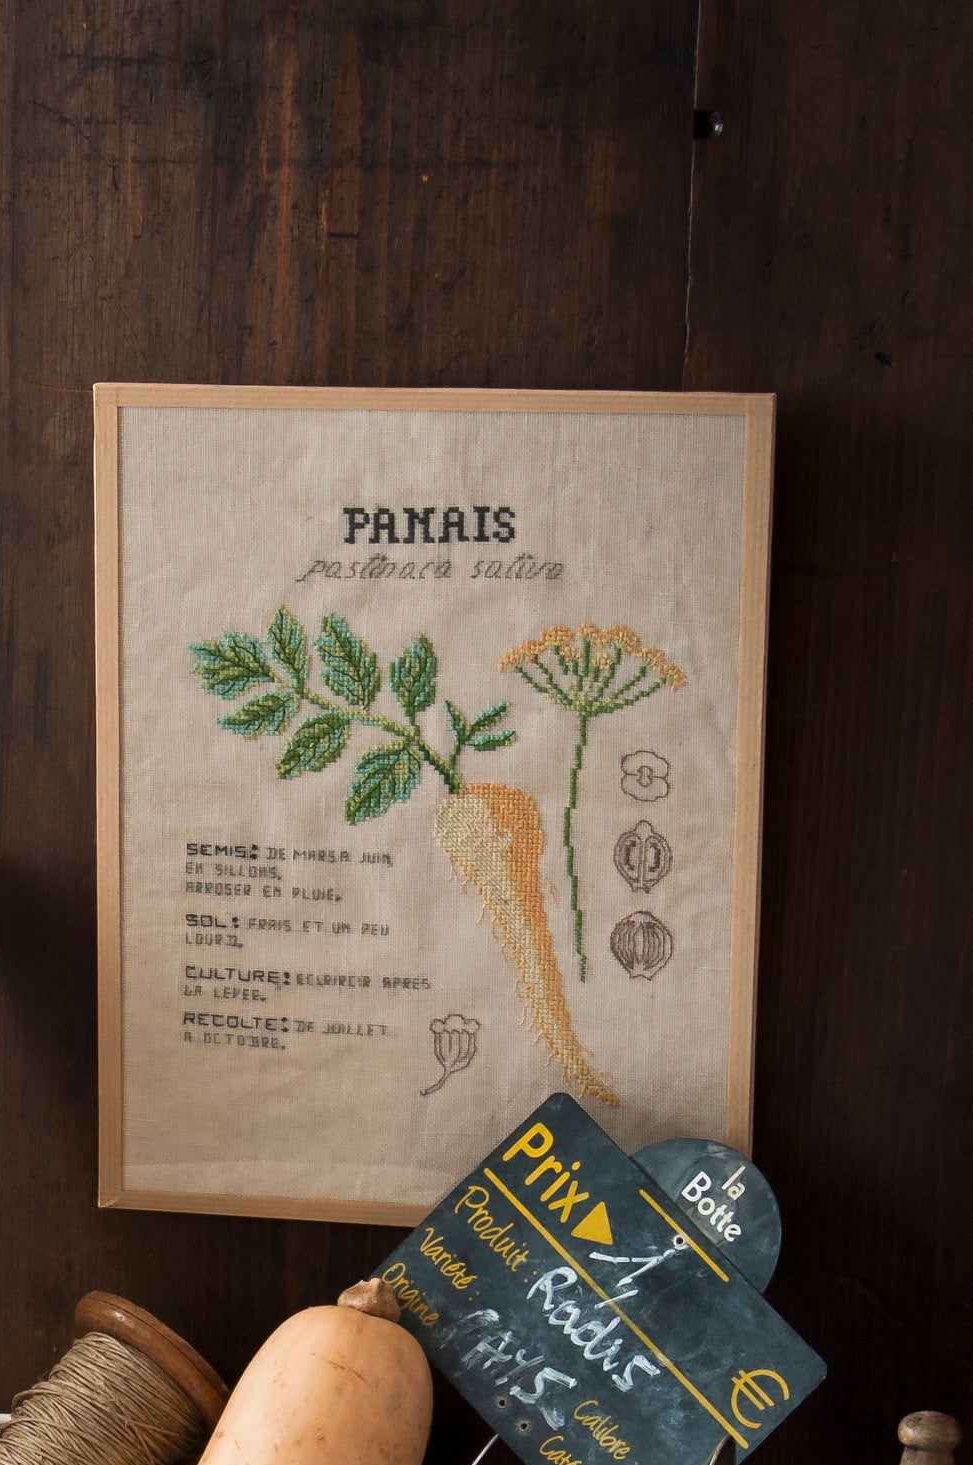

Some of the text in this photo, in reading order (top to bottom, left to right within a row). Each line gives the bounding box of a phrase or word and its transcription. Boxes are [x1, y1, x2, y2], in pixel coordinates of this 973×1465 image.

[343, 504, 516, 544] PANAIS
[296, 552, 565, 581] pastinaca sativa
[266, 847, 286, 861] DE
[293, 848, 335, 864] MARS
[185, 862, 204, 875] EN
[185, 881, 251, 896] ARROSER
[262, 886, 281, 898] EN
[248, 918, 292, 932] FRAIS
[302, 920, 324, 933] ET
[332, 922, 350, 935] UN
[361, 922, 390, 936] PEU
[183, 984, 203, 997] LA
[382, 976, 431, 990] APRES
[294, 1020, 315, 1033] DE
[323, 1021, 388, 1036] JUILLET
[183, 1032, 193, 1043] A
[501, 1122, 590, 1225] Prix
[721, 1163, 746, 1200] la
[680, 1170, 744, 1243] Botte
